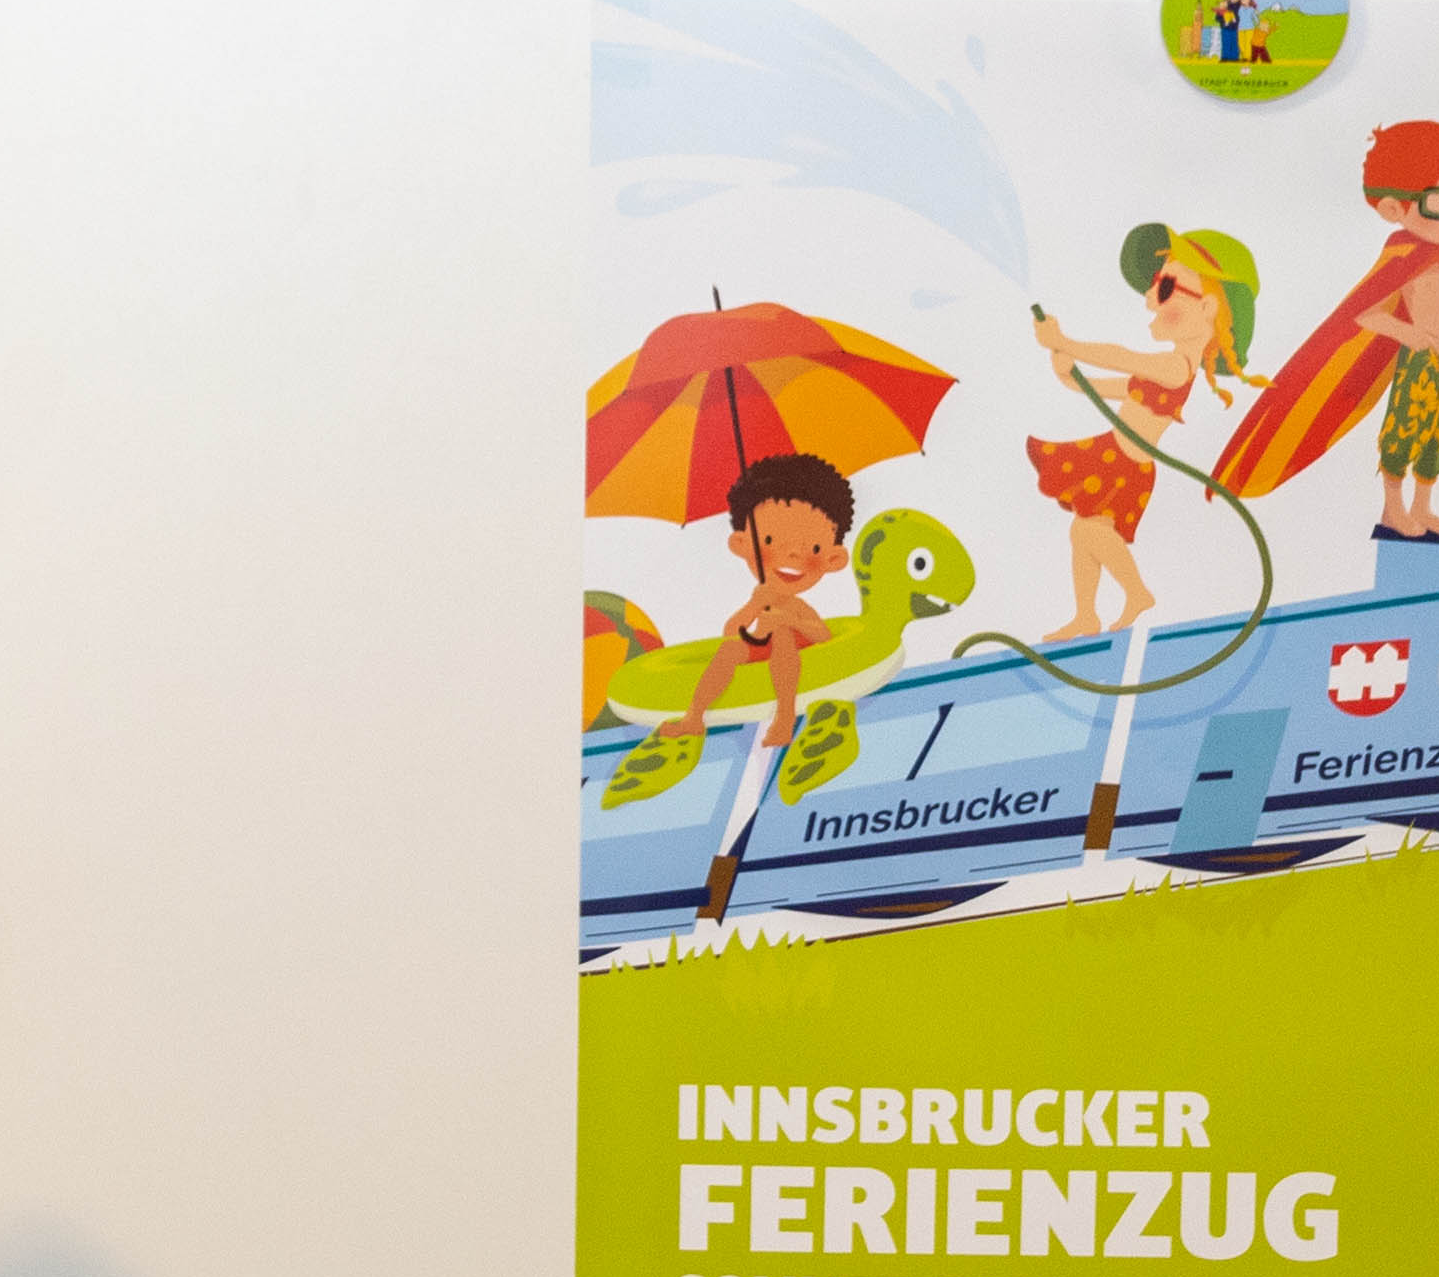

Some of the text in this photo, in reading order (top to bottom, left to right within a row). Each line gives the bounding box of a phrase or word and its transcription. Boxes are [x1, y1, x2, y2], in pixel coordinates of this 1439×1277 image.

[804, 784, 1060, 842] Innsbrucker
[678, 1084, 1211, 1148] INNSBRUCKER
[678, 1164, 1340, 1262] FERIENZUG
